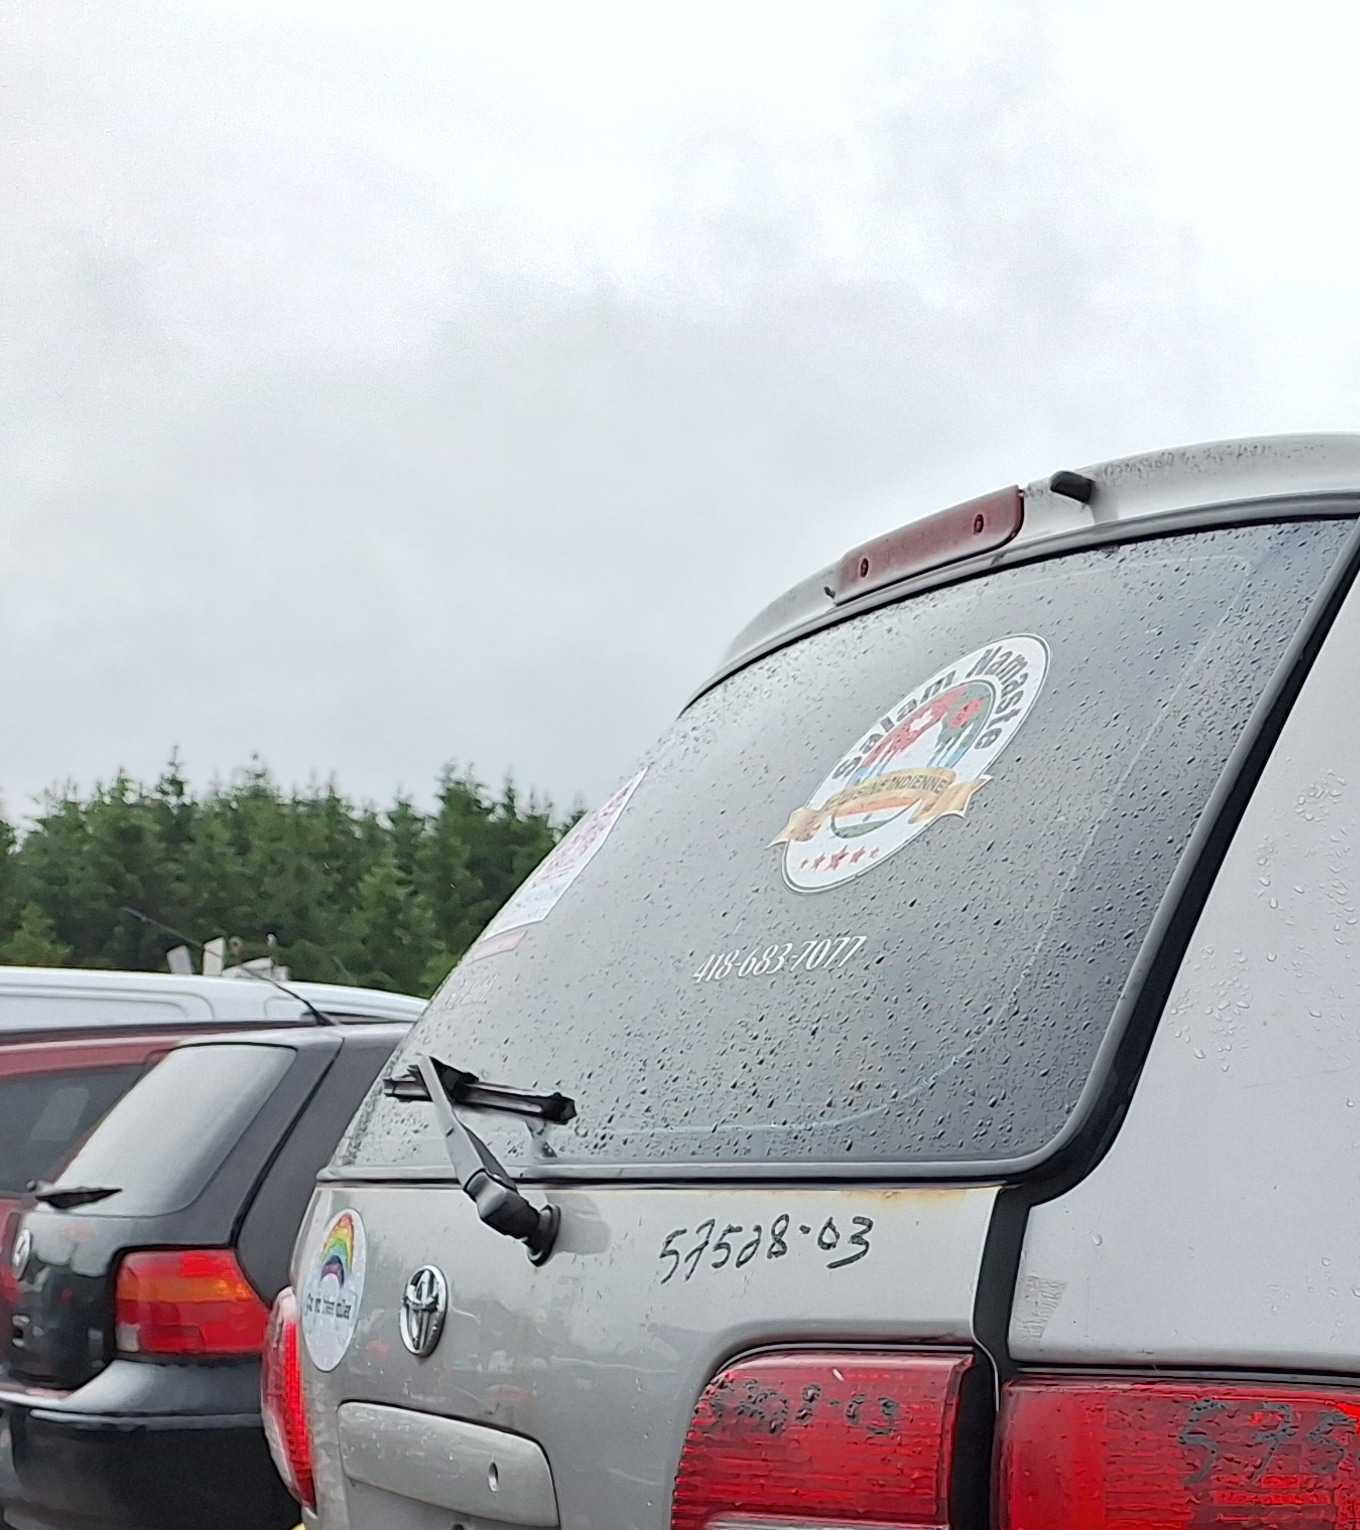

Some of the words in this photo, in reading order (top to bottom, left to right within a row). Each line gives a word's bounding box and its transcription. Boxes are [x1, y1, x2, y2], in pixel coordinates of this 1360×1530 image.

[831, 669, 956, 780] Salam
[692, 935, 868, 984] 418-683-7077
[658, 1213, 875, 1285] 57528-03
